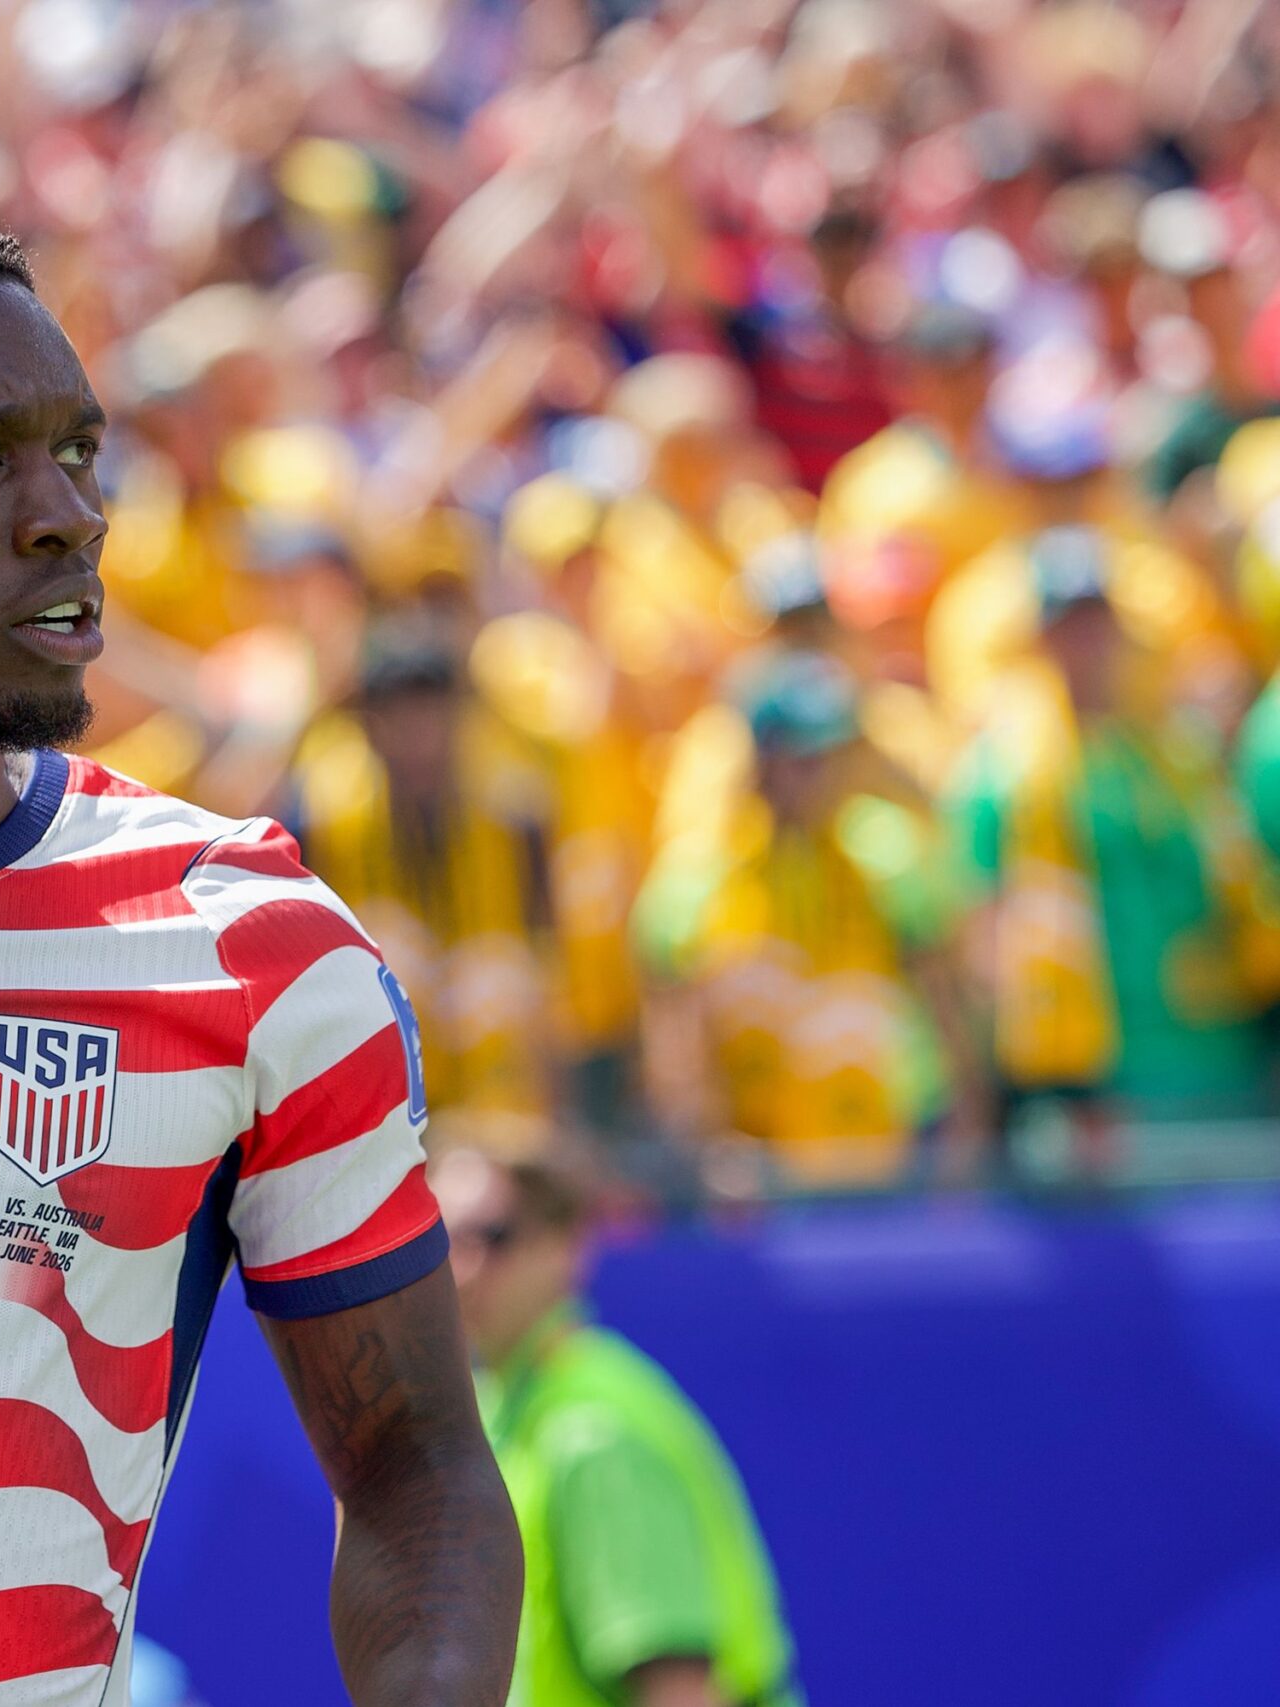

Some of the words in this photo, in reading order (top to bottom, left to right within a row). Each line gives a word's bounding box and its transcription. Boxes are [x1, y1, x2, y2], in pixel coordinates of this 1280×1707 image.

[5, 1197, 27, 1217] VS.
[32, 1203, 105, 1232] AUSTRALIA
[55, 1231, 80, 1251] WA
[0, 1243, 40, 1265] JUNE
[39, 1251, 74, 1272] 2026
